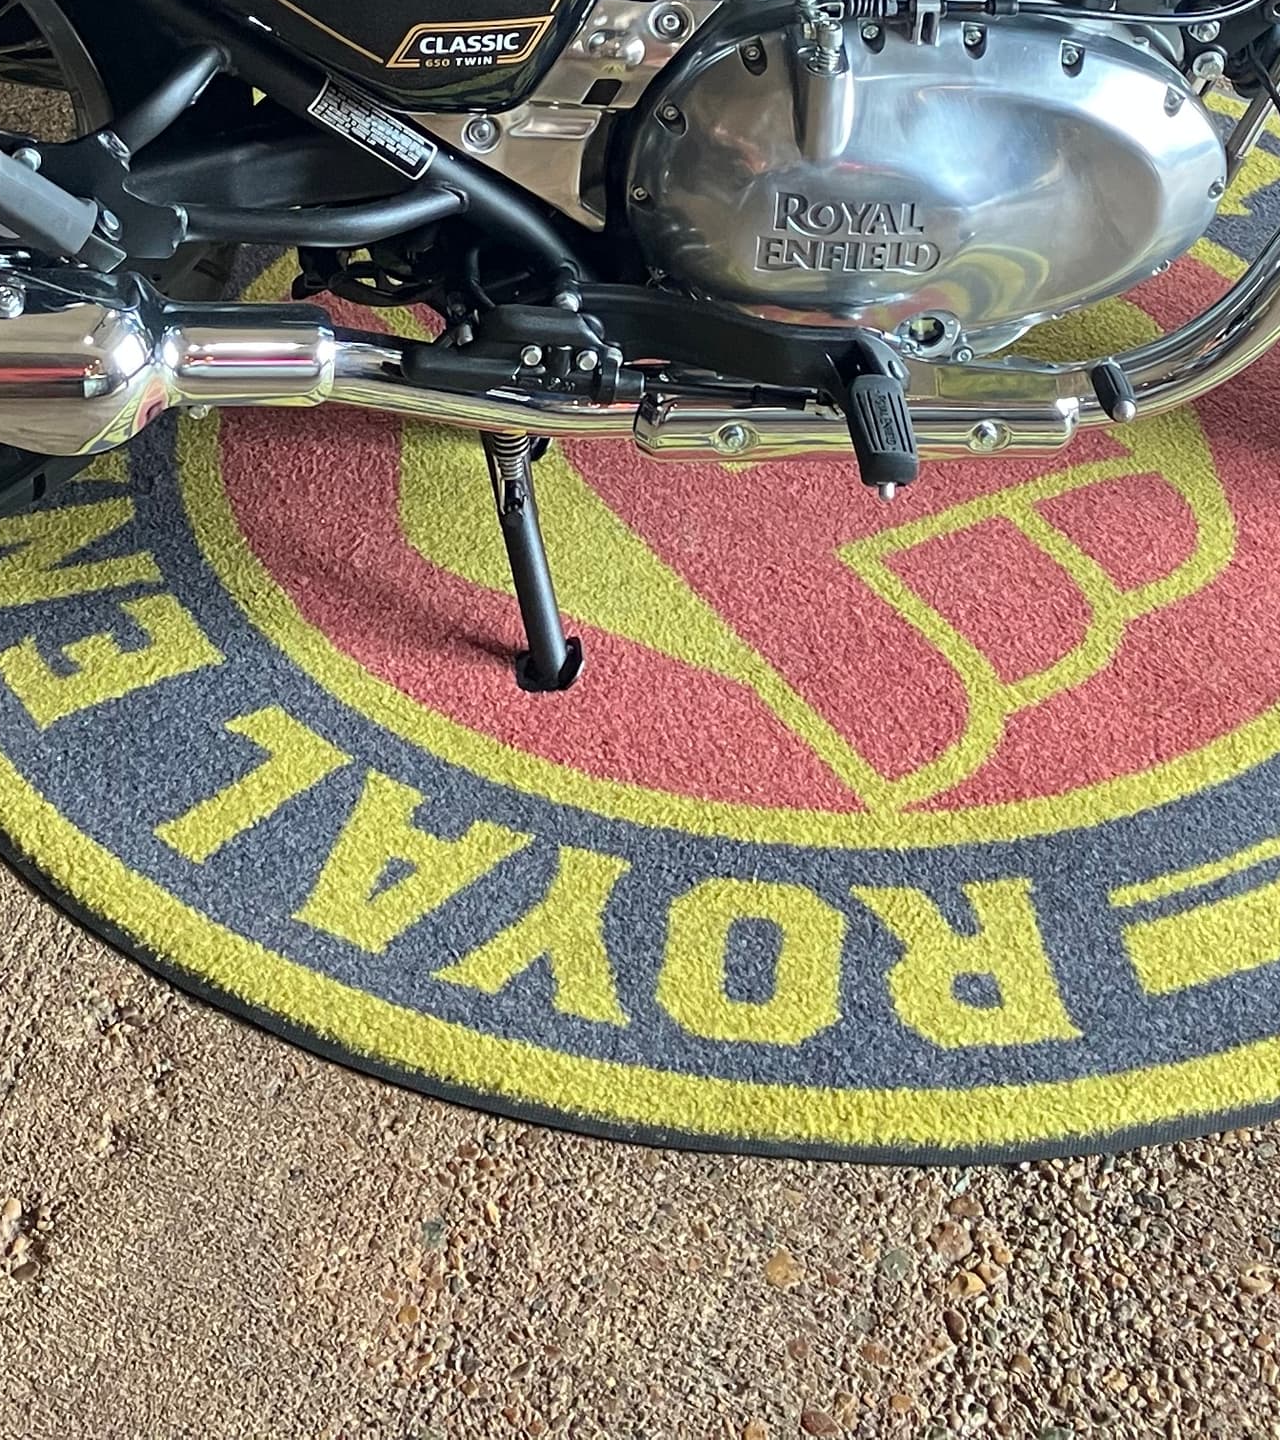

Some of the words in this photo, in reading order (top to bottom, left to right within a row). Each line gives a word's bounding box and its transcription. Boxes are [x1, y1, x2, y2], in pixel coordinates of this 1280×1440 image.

[420, 32, 520, 55] CLASSIC
[425, 58, 451, 68] 650
[455, 56, 493, 67] TWIN
[773, 191, 924, 237] ROYAL
[754, 235, 941, 275] ENFIELD
[154, 703, 1084, 1050] ROYAL
